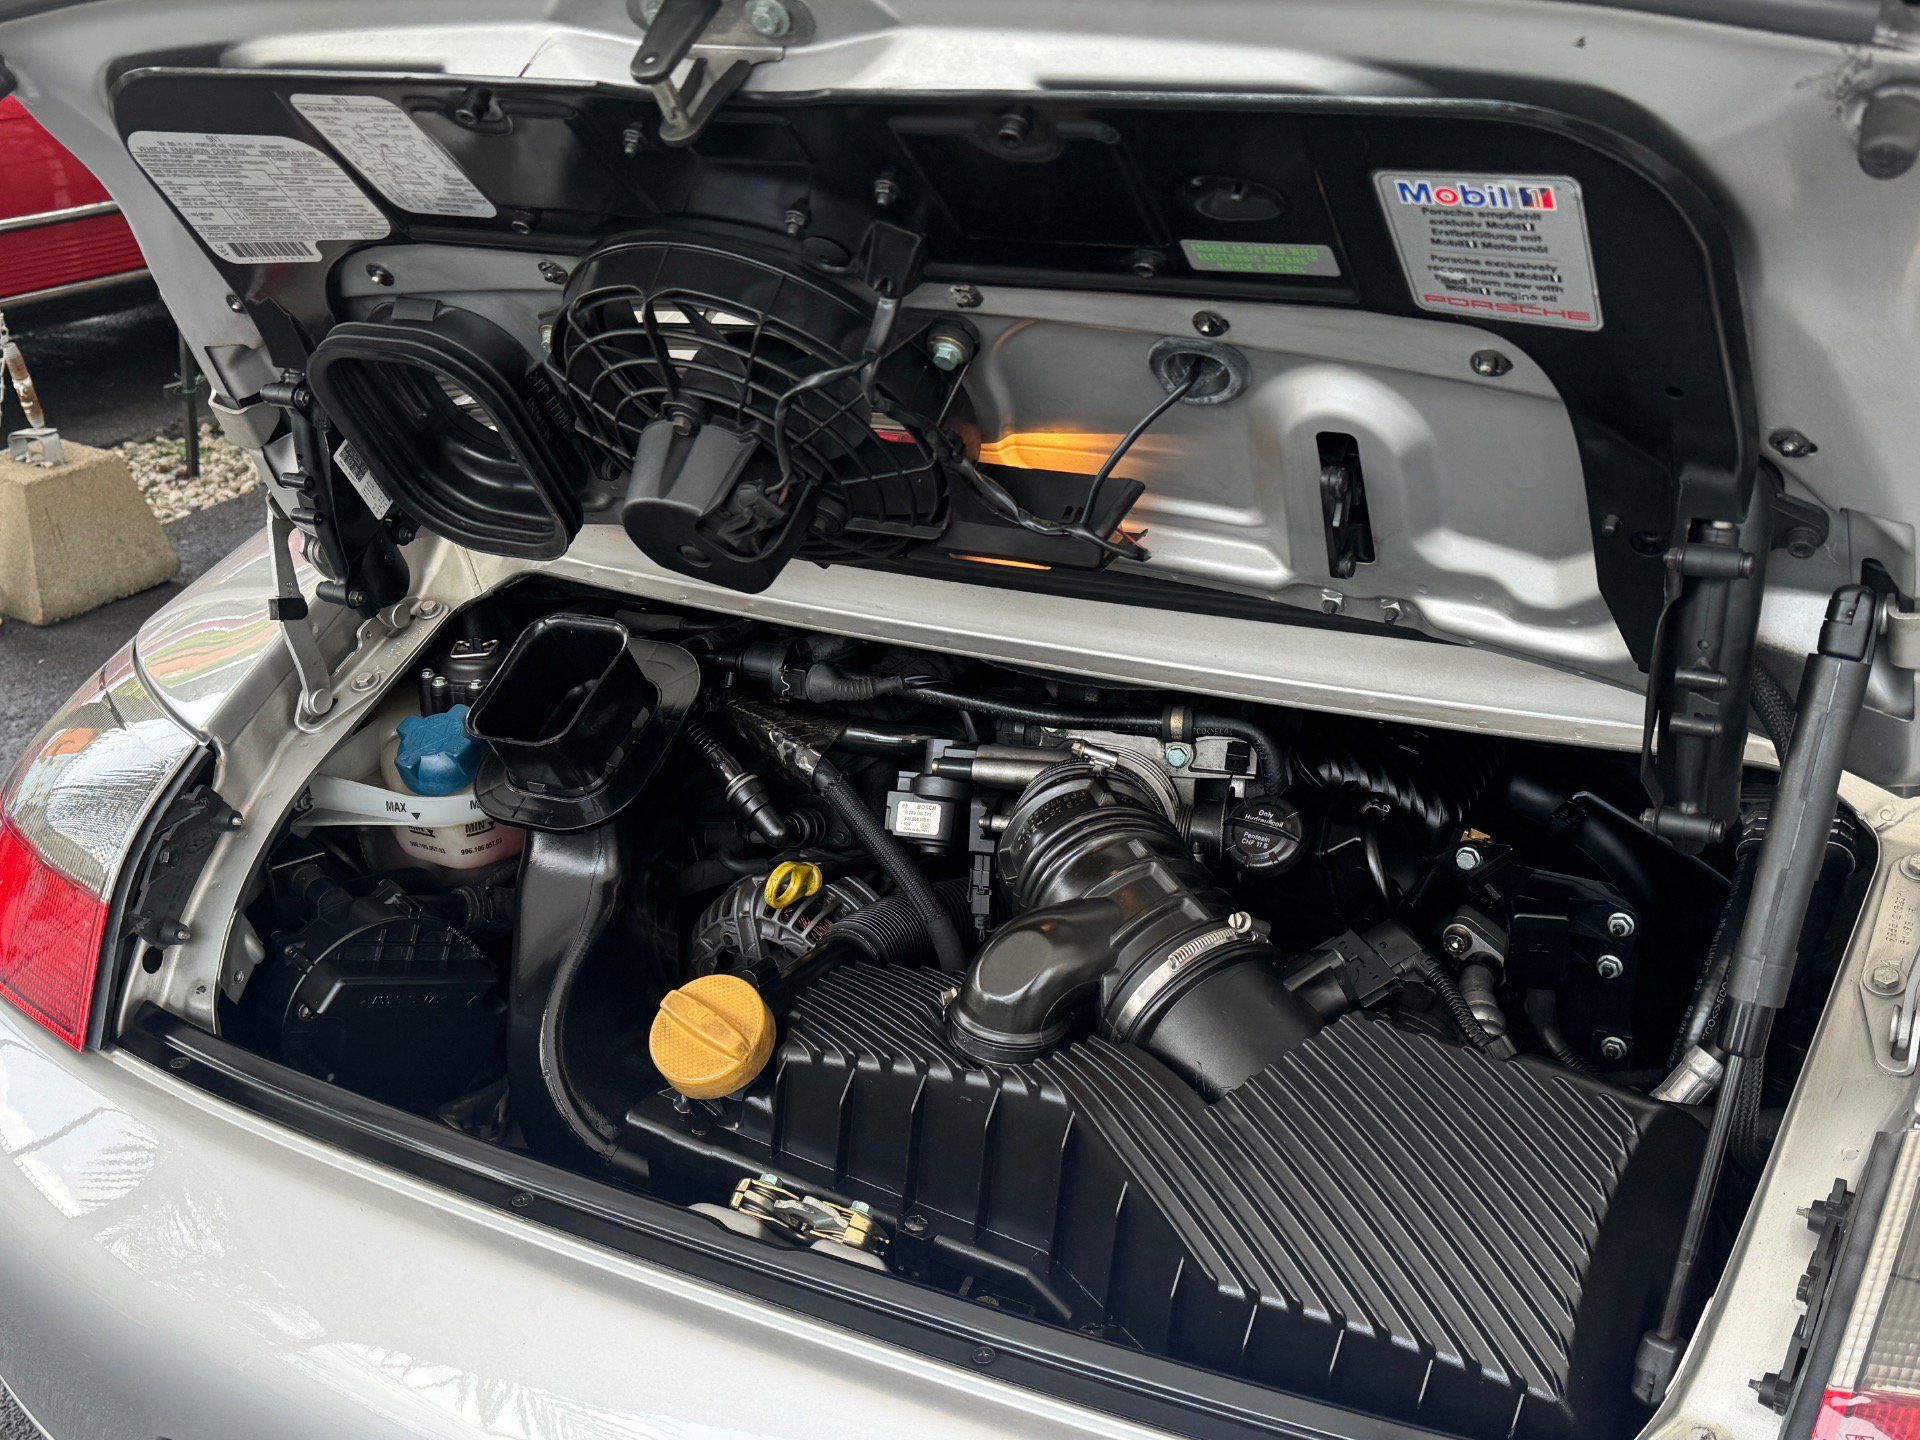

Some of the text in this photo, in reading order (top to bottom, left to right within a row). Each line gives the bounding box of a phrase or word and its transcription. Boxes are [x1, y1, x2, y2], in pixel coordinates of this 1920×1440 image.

[1394, 180, 1512, 209] Mobil
[1421, 207, 1542, 222] Porsche empfiehlt
[1429, 219, 1483, 229] exklusiv
[1431, 227, 1542, 242] Erstbefüllung mit
[1481, 241, 1549, 254] Motorenöl
[1430, 254, 1558, 274] Porsche exclusively
[1427, 265, 1511, 279] recommends
[1471, 277, 1502, 287] from
[1504, 281, 1532, 290] new
[1535, 283, 1565, 293] with
[1493, 290, 1539, 302] engine
[1541, 294, 1558, 302] oil
[1424, 294, 1591, 322] PORSCHE
[385, 800, 407, 813] MAX
[1258, 809, 1274, 819] Only
[465, 821, 486, 834] MIN
[1241, 838, 1255, 846] CHF
[1244, 831, 1270, 843] Pentosin
